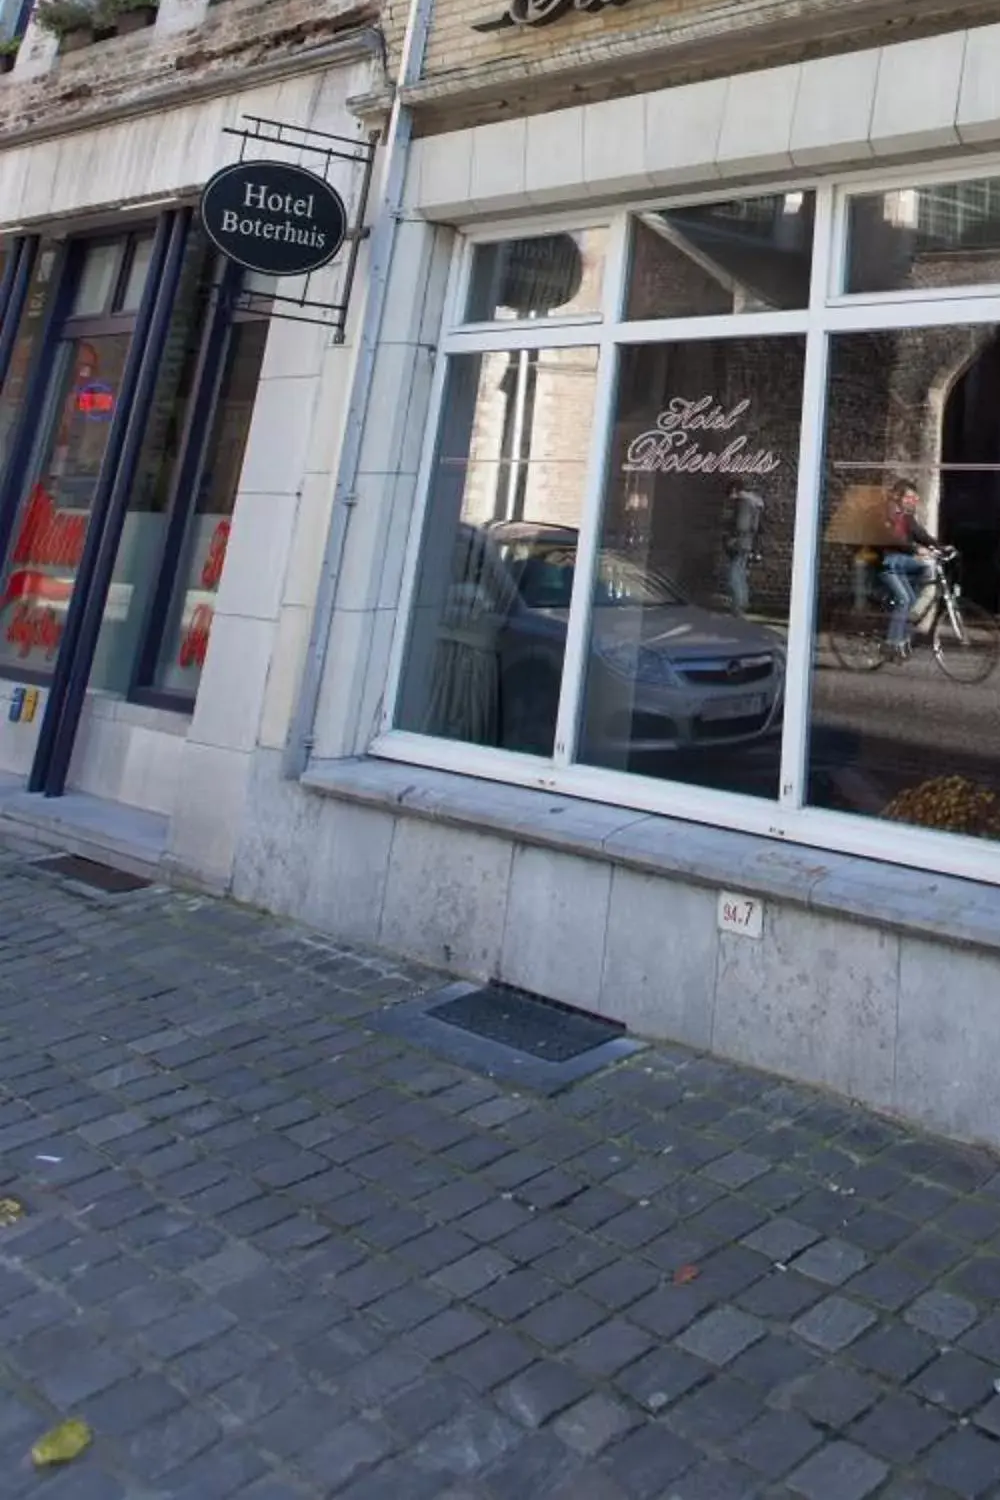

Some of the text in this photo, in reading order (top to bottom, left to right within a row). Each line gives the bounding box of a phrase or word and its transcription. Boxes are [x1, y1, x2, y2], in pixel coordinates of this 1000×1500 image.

[243, 182, 314, 218] Hotel
[220, 209, 326, 249] Boterhuis
[657, 395, 750, 431] Hotel
[622, 429, 782, 474] Boterhuis
